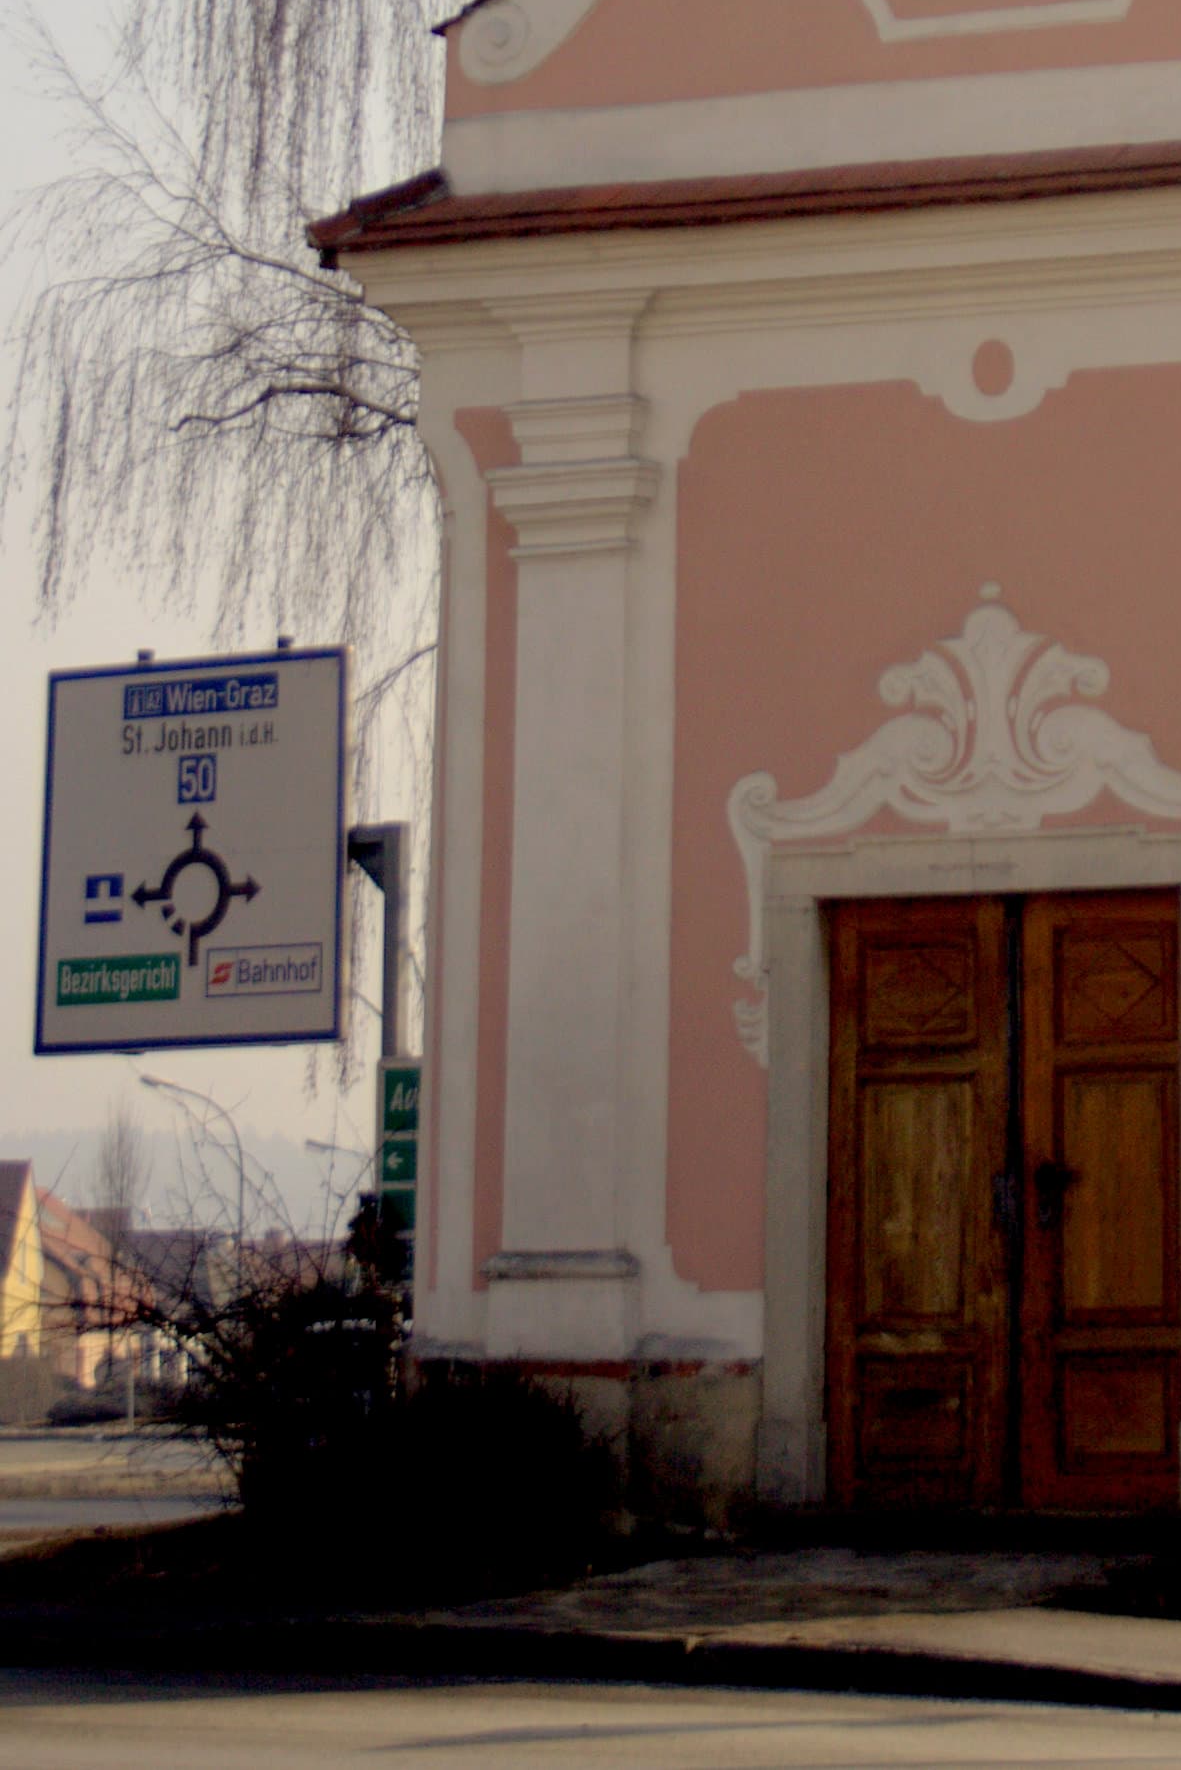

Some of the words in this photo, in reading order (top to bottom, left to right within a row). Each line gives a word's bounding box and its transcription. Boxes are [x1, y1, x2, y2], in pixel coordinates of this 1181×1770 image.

[166, 680, 277, 714] Wien-Graz
[122, 723, 148, 755] St.
[153, 720, 233, 752] Johann
[180, 758, 214, 800] 50
[60, 958, 178, 999] Bezirksgericht
[236, 955, 319, 985] Bahnhof
